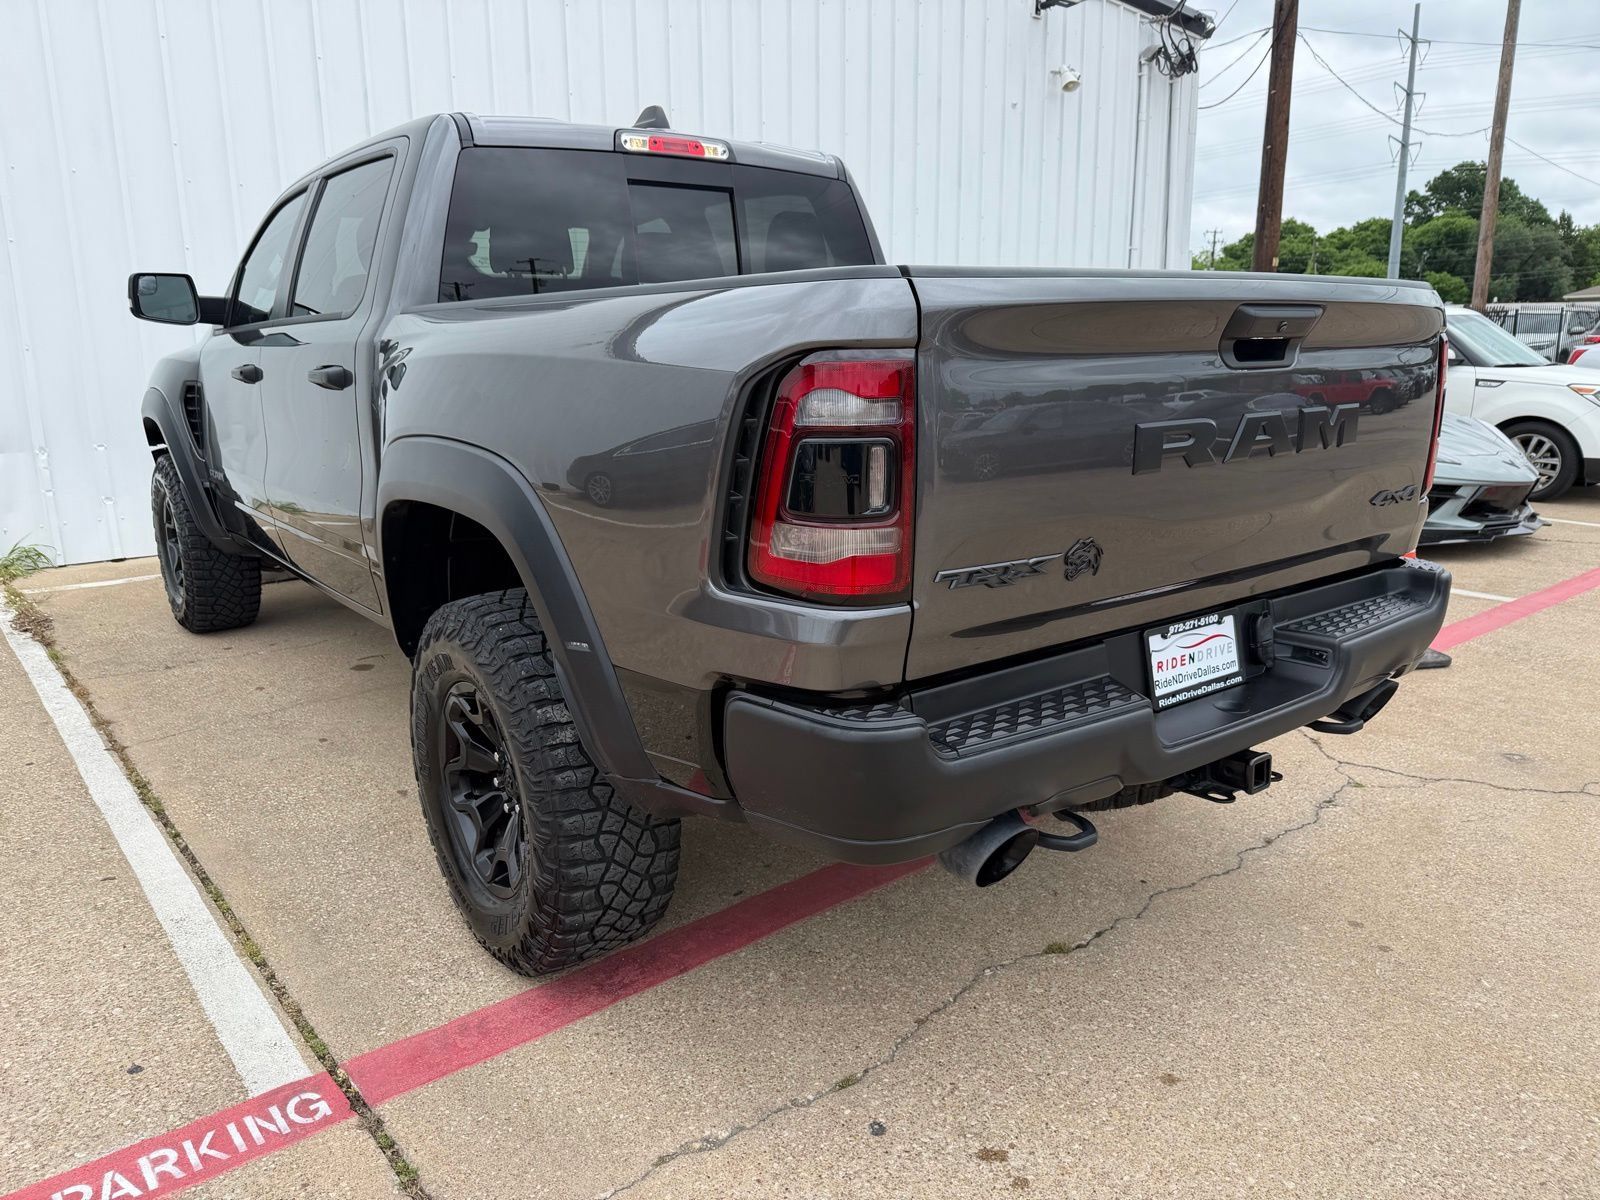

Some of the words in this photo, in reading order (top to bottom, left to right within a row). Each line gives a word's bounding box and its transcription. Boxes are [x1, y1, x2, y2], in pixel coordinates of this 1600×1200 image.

[1132, 403, 1360, 475] RAM
[799, 472, 860, 484] RM
[933, 552, 1064, 589] TRX
[1168, 614, 1219, 633] 972-271-5100
[1154, 659, 1237, 690] RideNDriveDallas.com
[1158, 676, 1243, 708] RideNDriveDallas.com
